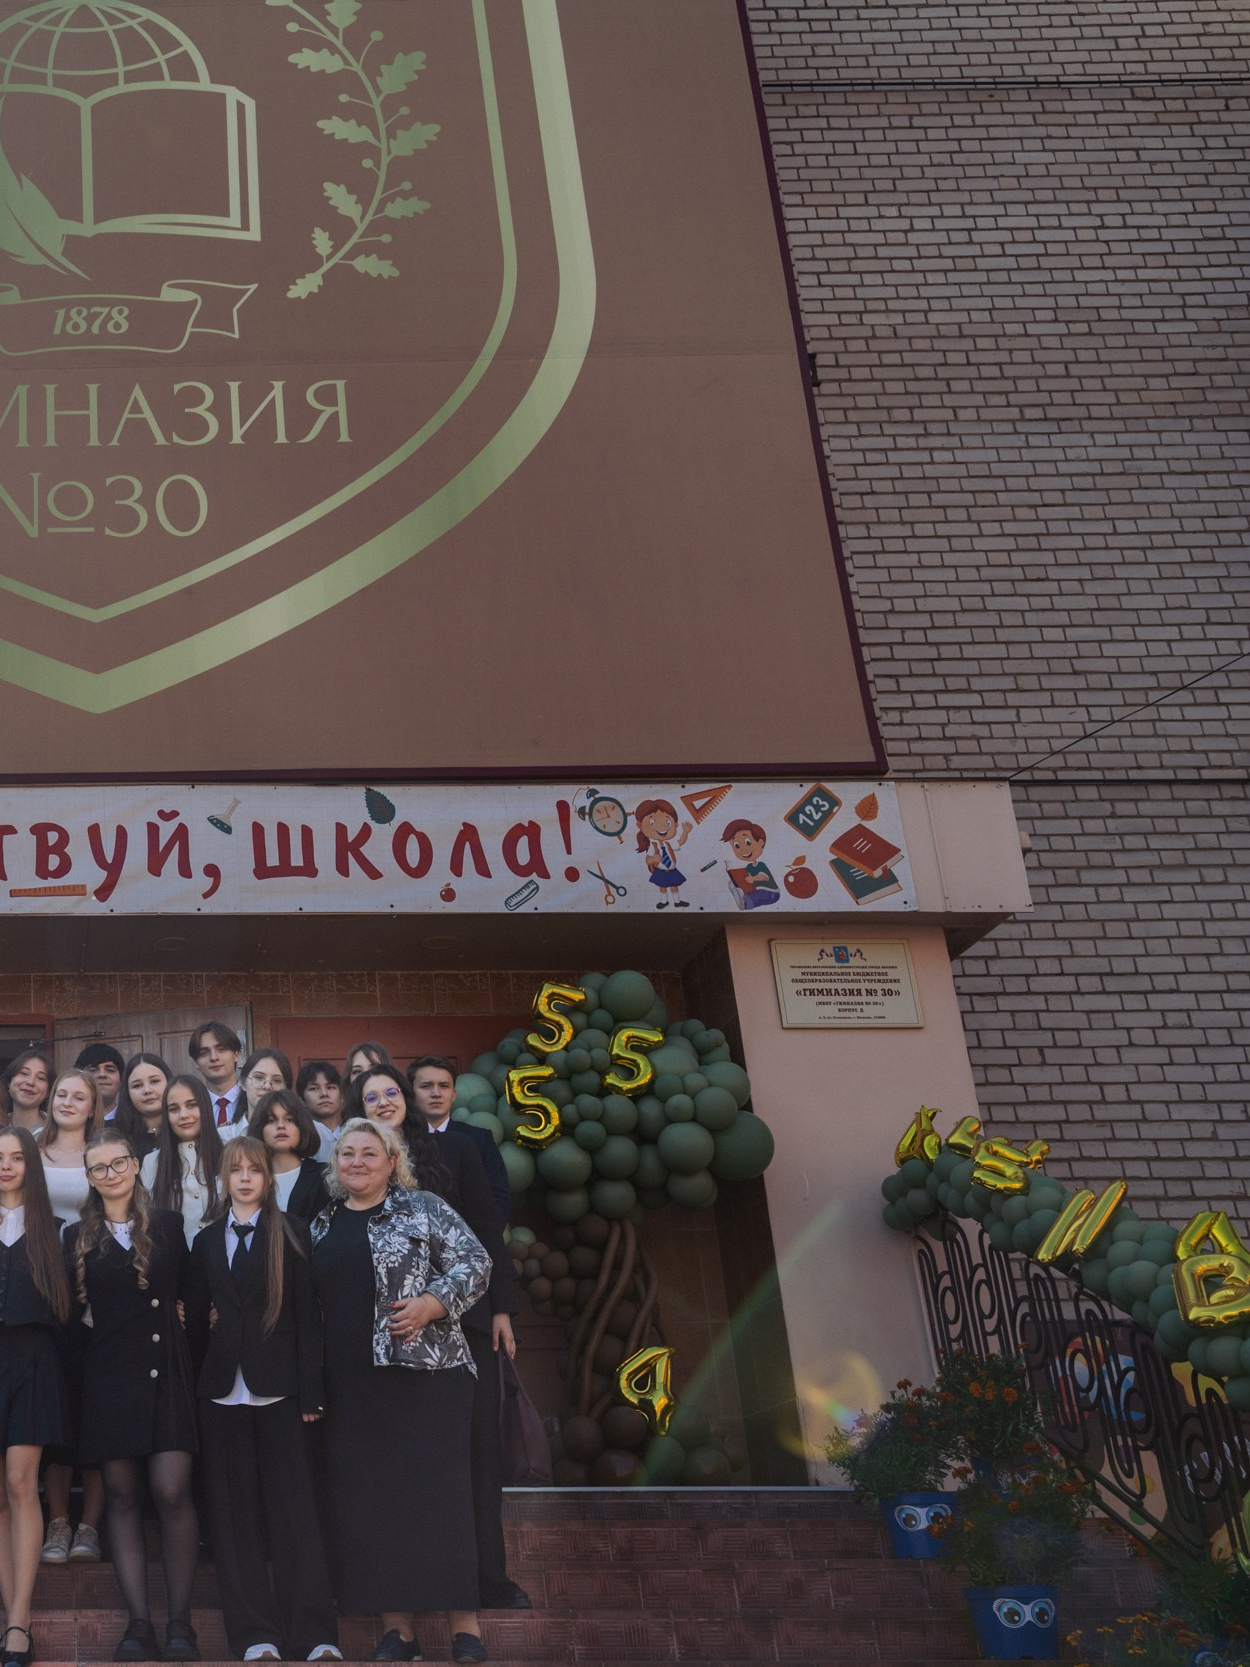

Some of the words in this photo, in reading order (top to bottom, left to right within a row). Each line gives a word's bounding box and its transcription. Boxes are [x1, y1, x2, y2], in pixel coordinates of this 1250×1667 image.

[52, 304, 130, 336] 1878
[251, 799, 581, 884] школа!
[798, 796, 830, 826] 123
[525, 980, 587, 1057] 5
[795, 988, 863, 997] «ГИМНАЗИЯ
[864, 988, 878, 997] №
[880, 988, 901, 997] 30»
[602, 1026, 665, 1097] 5
[505, 1063, 564, 1150] 5
